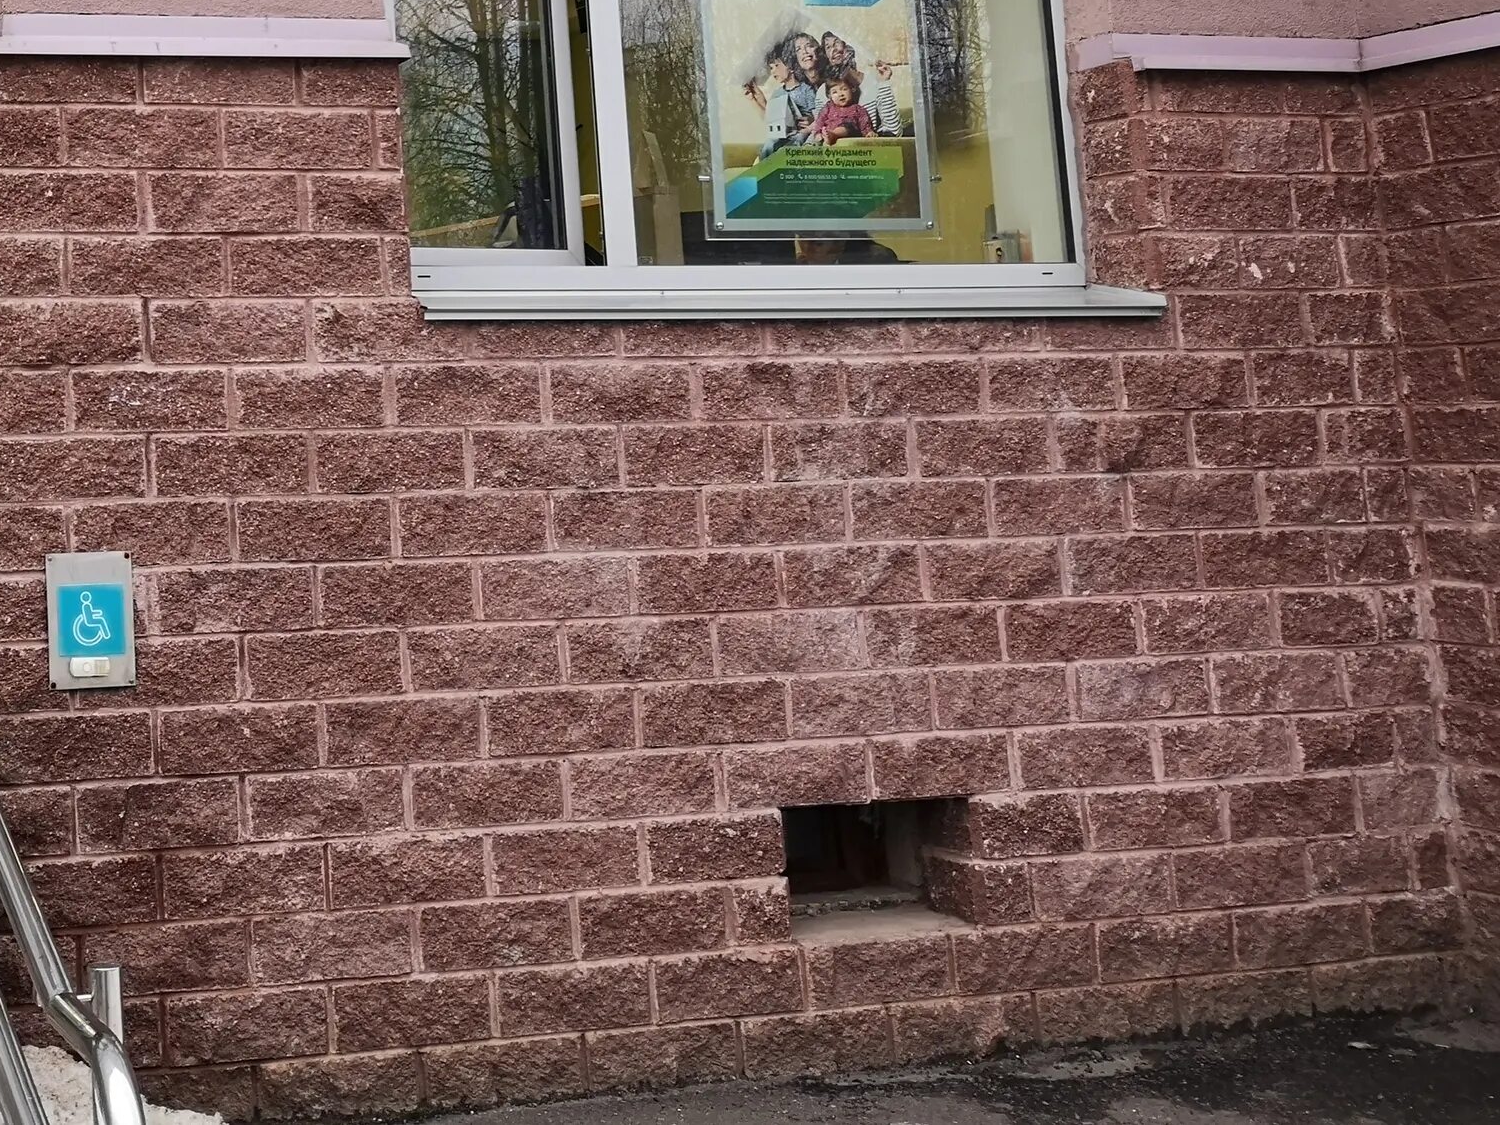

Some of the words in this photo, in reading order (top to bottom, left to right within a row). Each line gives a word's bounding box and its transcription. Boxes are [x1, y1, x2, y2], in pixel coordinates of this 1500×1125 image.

[785, 147, 823, 157] Крепкий
[824, 148, 872, 157] фундамент
[786, 159, 833, 167] надежного
[835, 158, 876, 167] будущего
